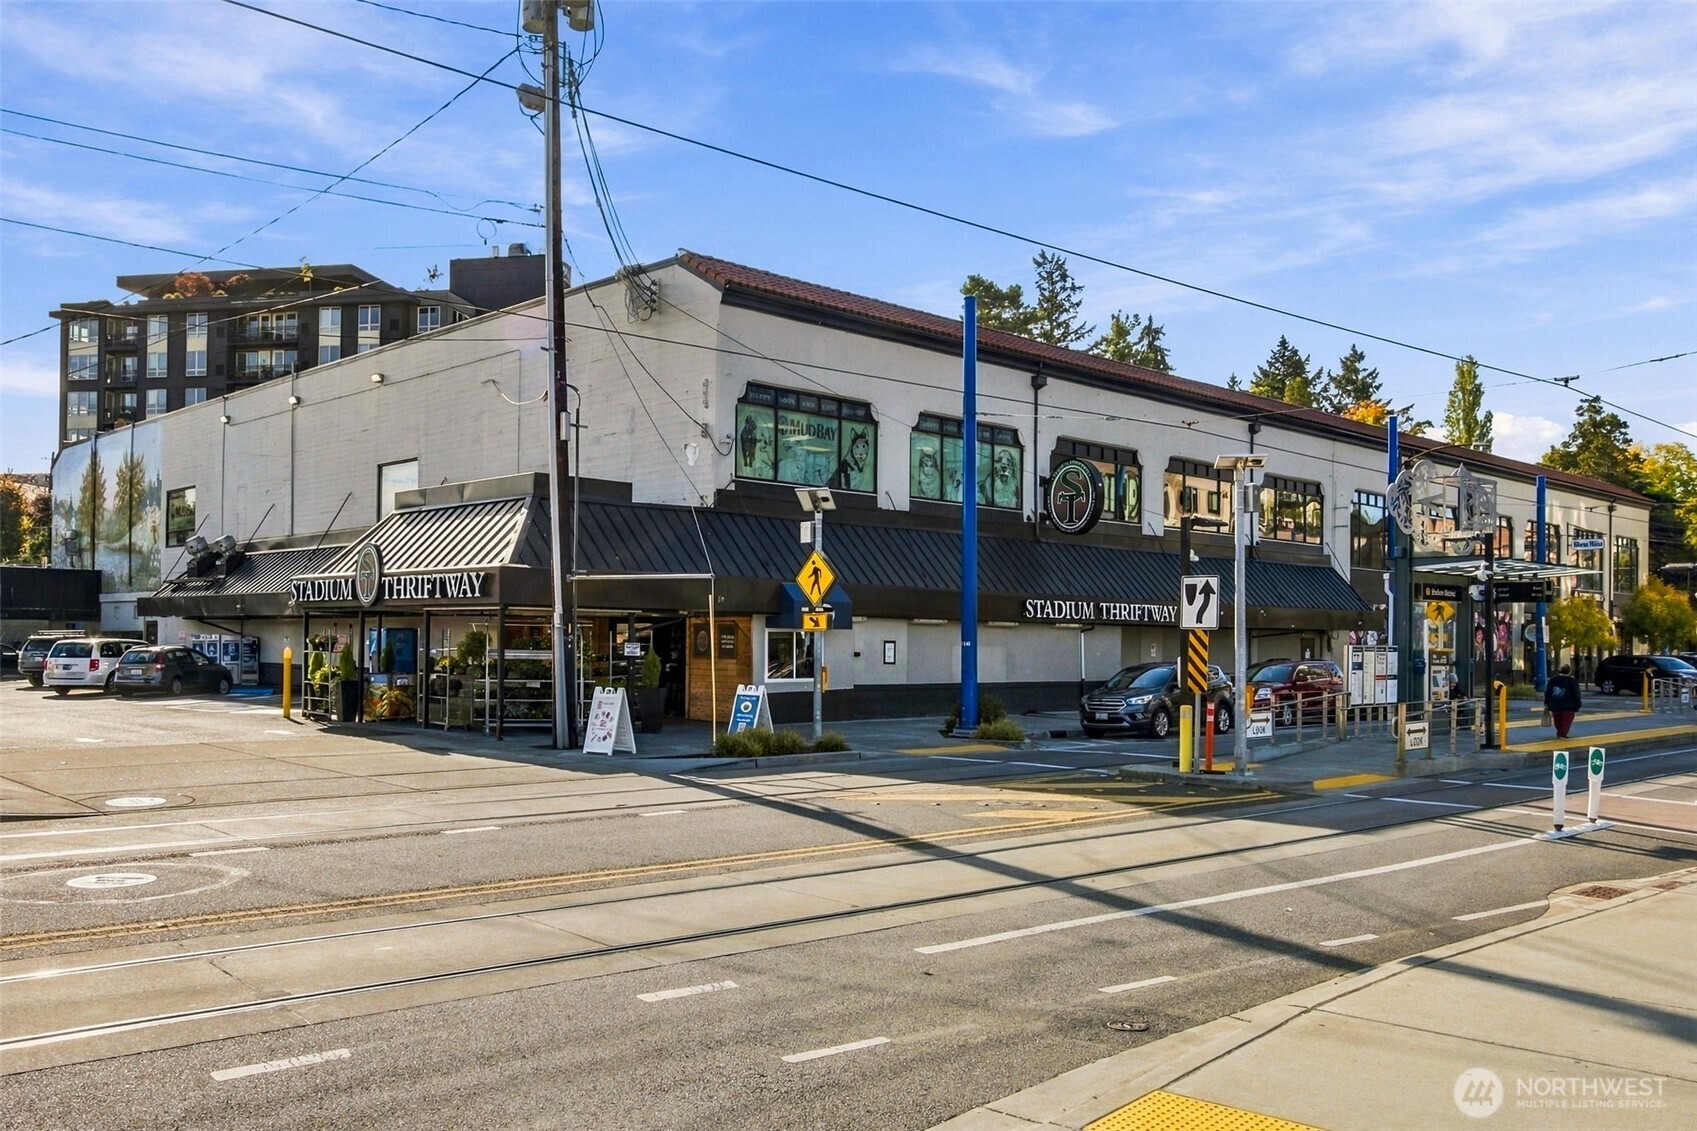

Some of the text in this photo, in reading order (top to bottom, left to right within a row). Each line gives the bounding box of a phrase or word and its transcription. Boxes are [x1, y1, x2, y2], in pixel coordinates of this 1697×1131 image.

[290, 571, 485, 602] STADIUM THRIFTWAY
[1025, 599, 1178, 622] STADIUM THRIFTWAY
[1252, 725, 1267, 735] LOOK
[1410, 736, 1424, 747] LOOK
